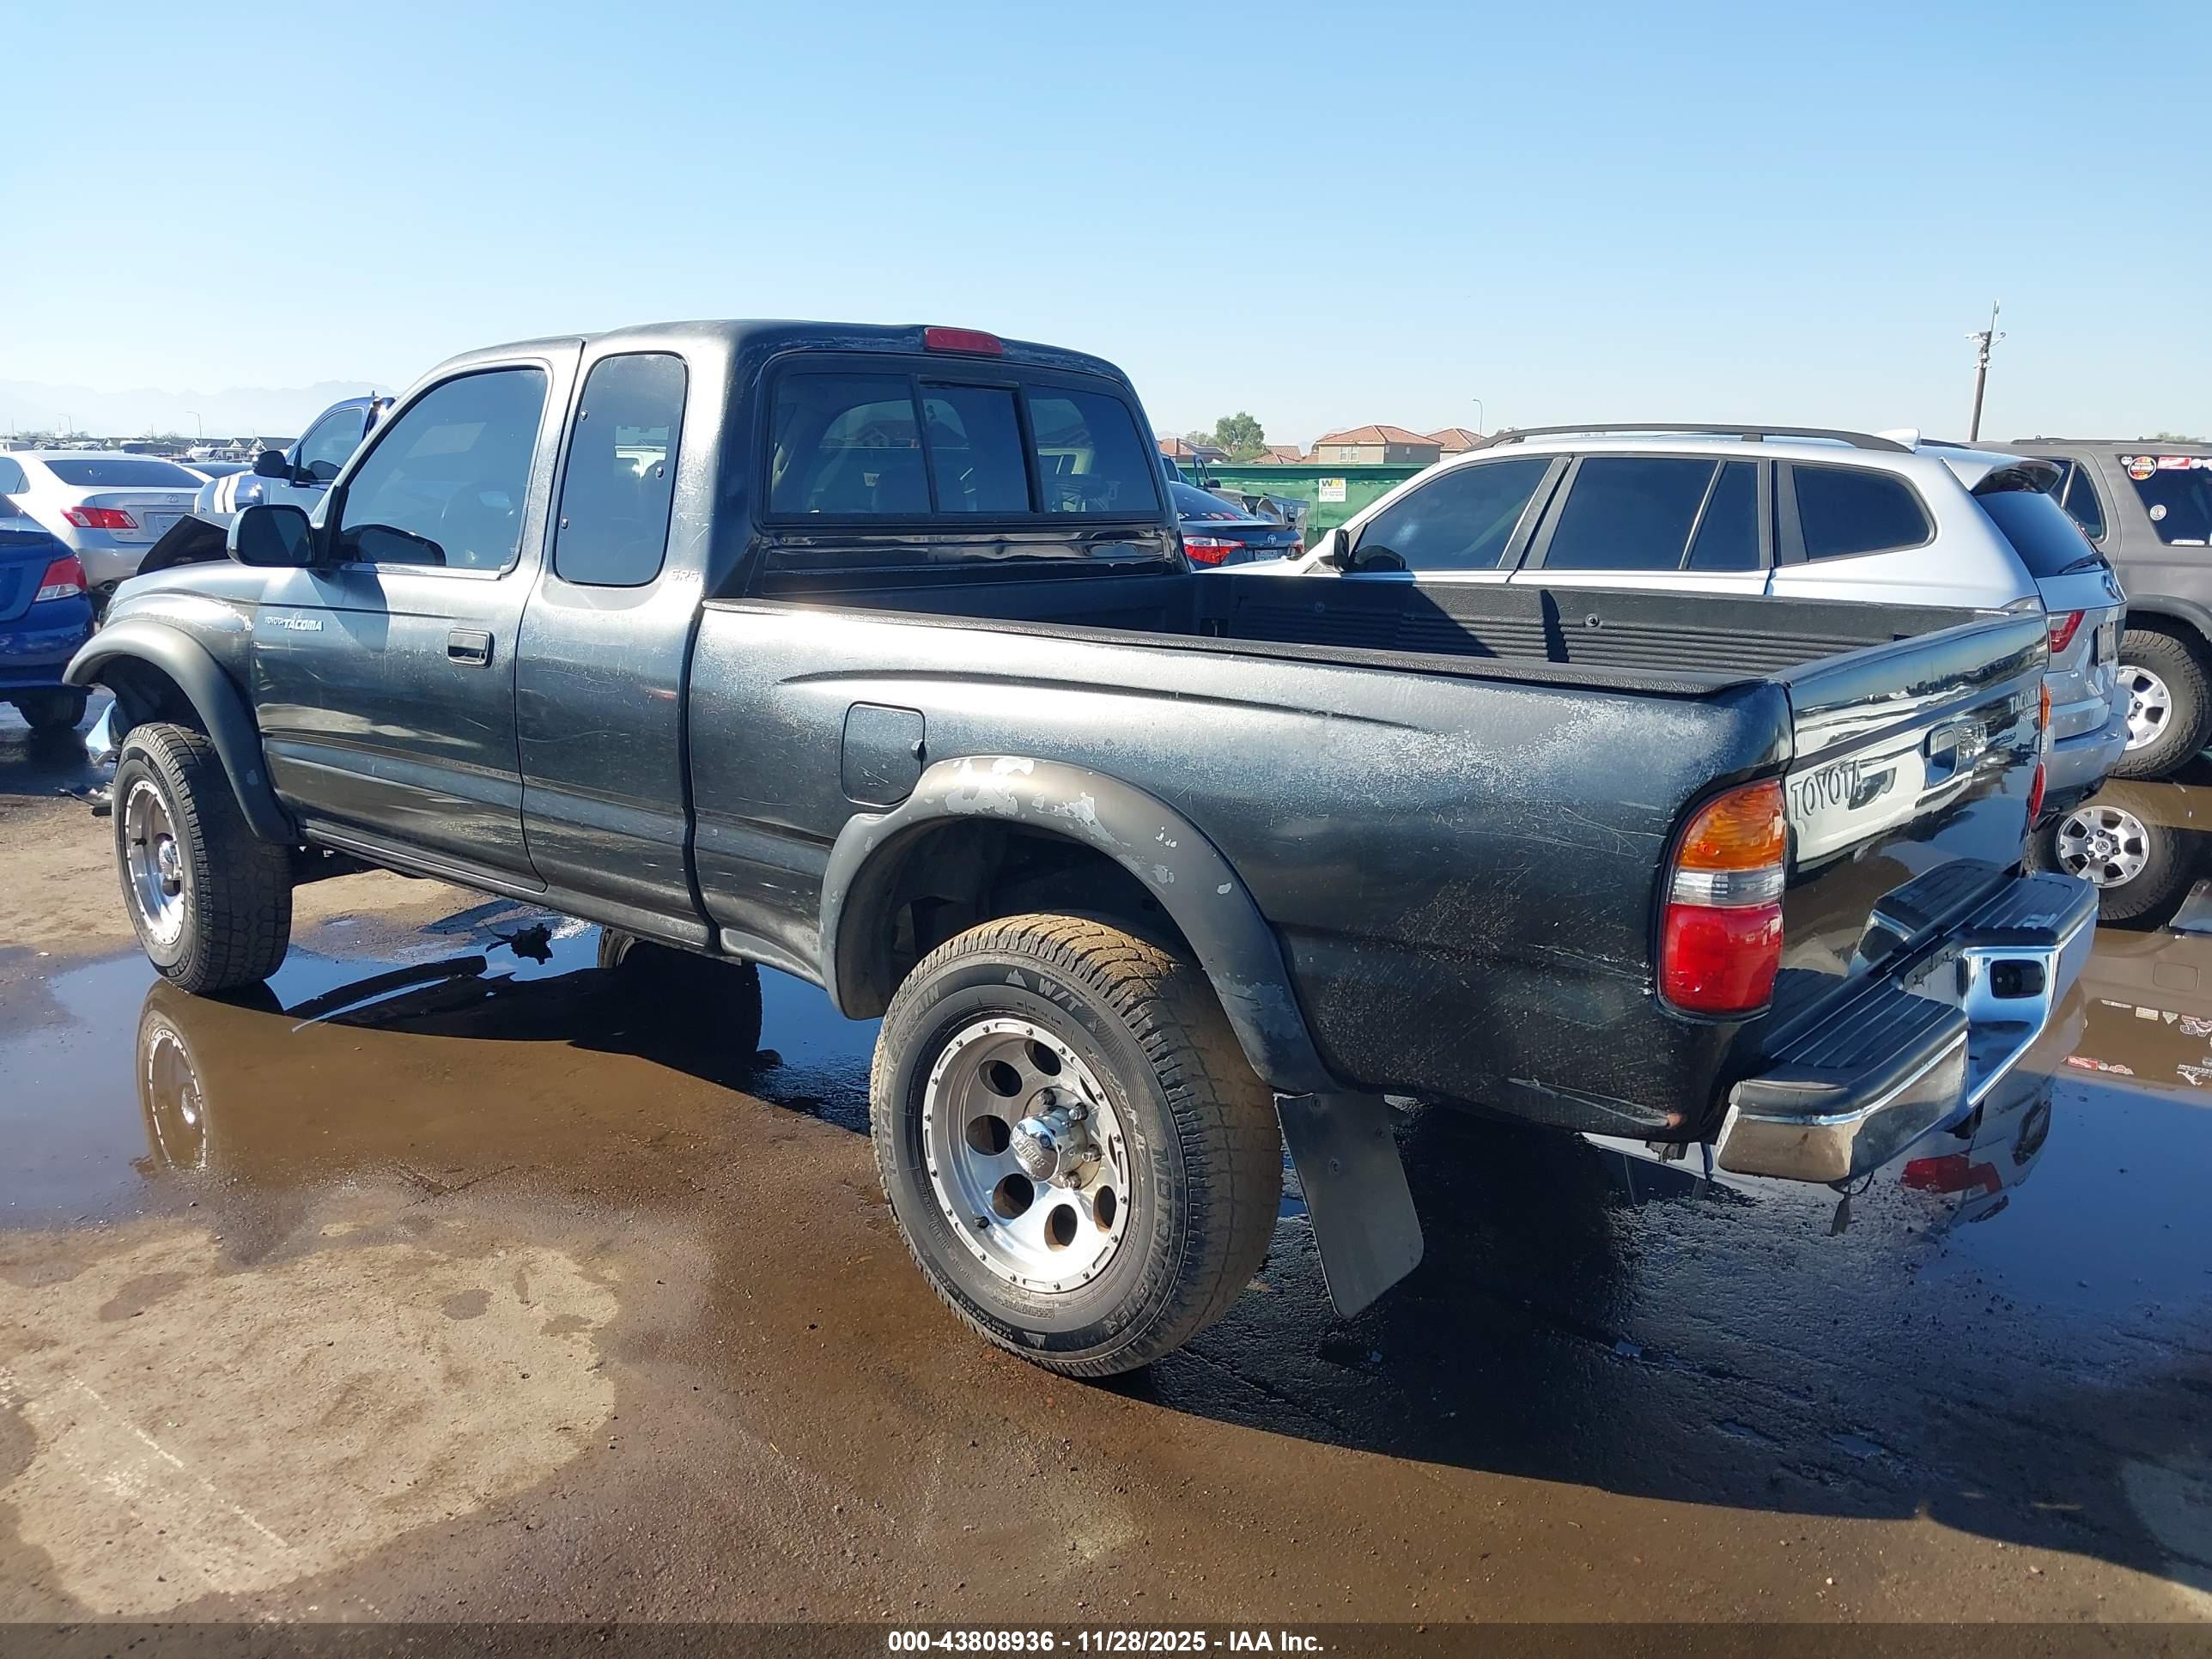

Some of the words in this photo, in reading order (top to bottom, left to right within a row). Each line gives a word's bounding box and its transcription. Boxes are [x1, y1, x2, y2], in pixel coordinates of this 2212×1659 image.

[264, 616, 283, 626] TOYOTA
[283, 618, 324, 632] TACOMA
[2008, 687, 2041, 715] TACOMA
[1790, 757, 1863, 821] TOYOTA
[1038, 977, 1084, 1012] W/T
